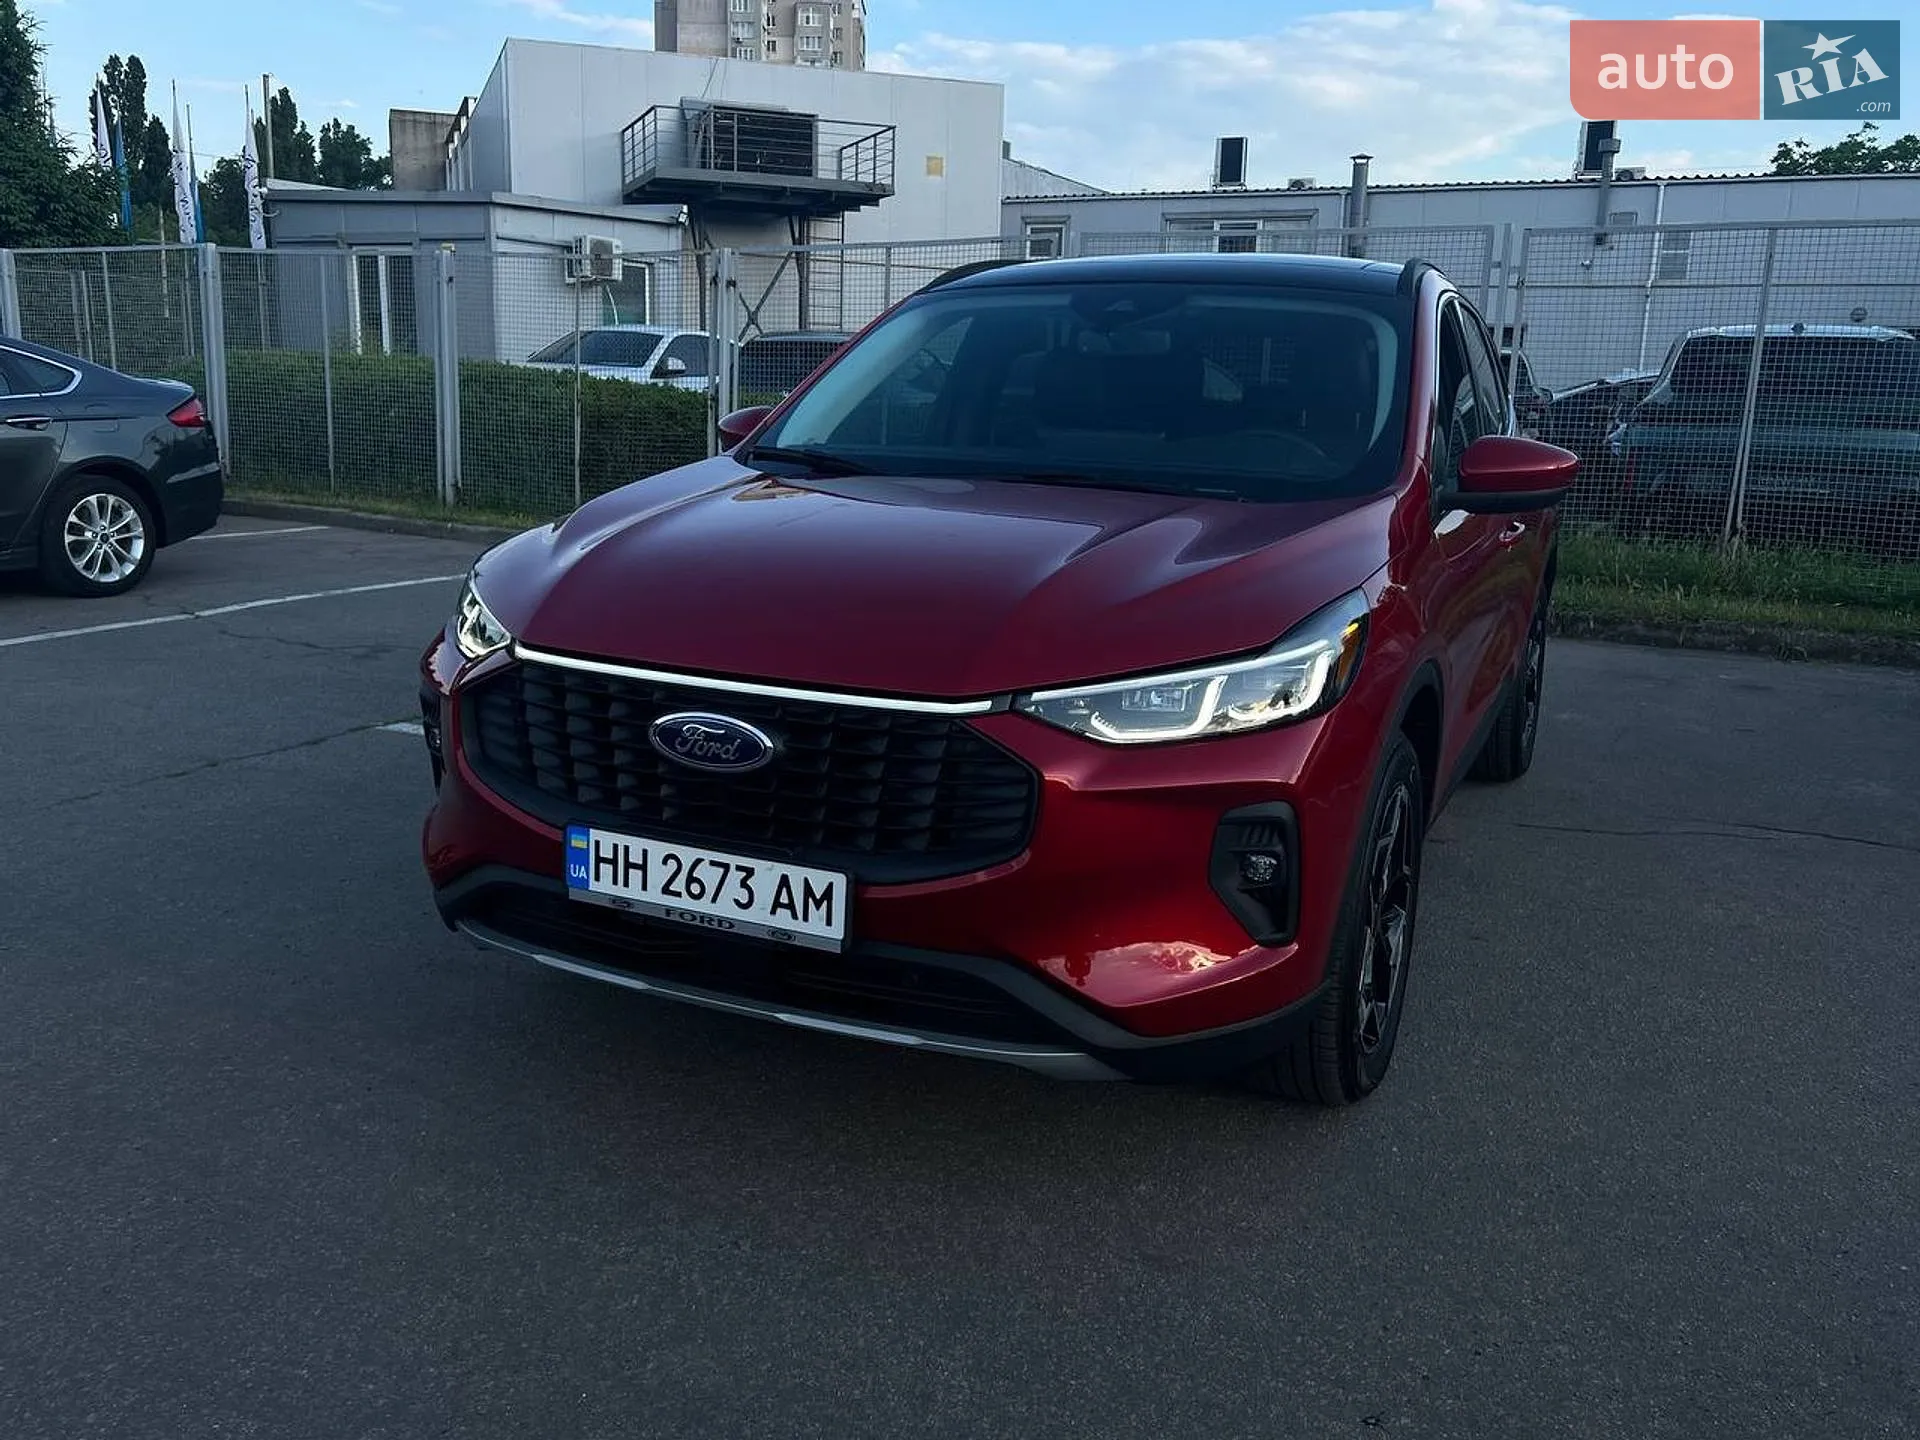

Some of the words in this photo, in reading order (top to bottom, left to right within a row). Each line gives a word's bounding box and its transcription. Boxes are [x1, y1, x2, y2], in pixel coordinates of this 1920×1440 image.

[675, 724, 741, 760] Ford
[570, 863, 588, 880] UA
[594, 839, 648, 891] HH
[661, 853, 755, 910] 2673
[769, 872, 834, 927] AM
[664, 908, 736, 930] FORD
